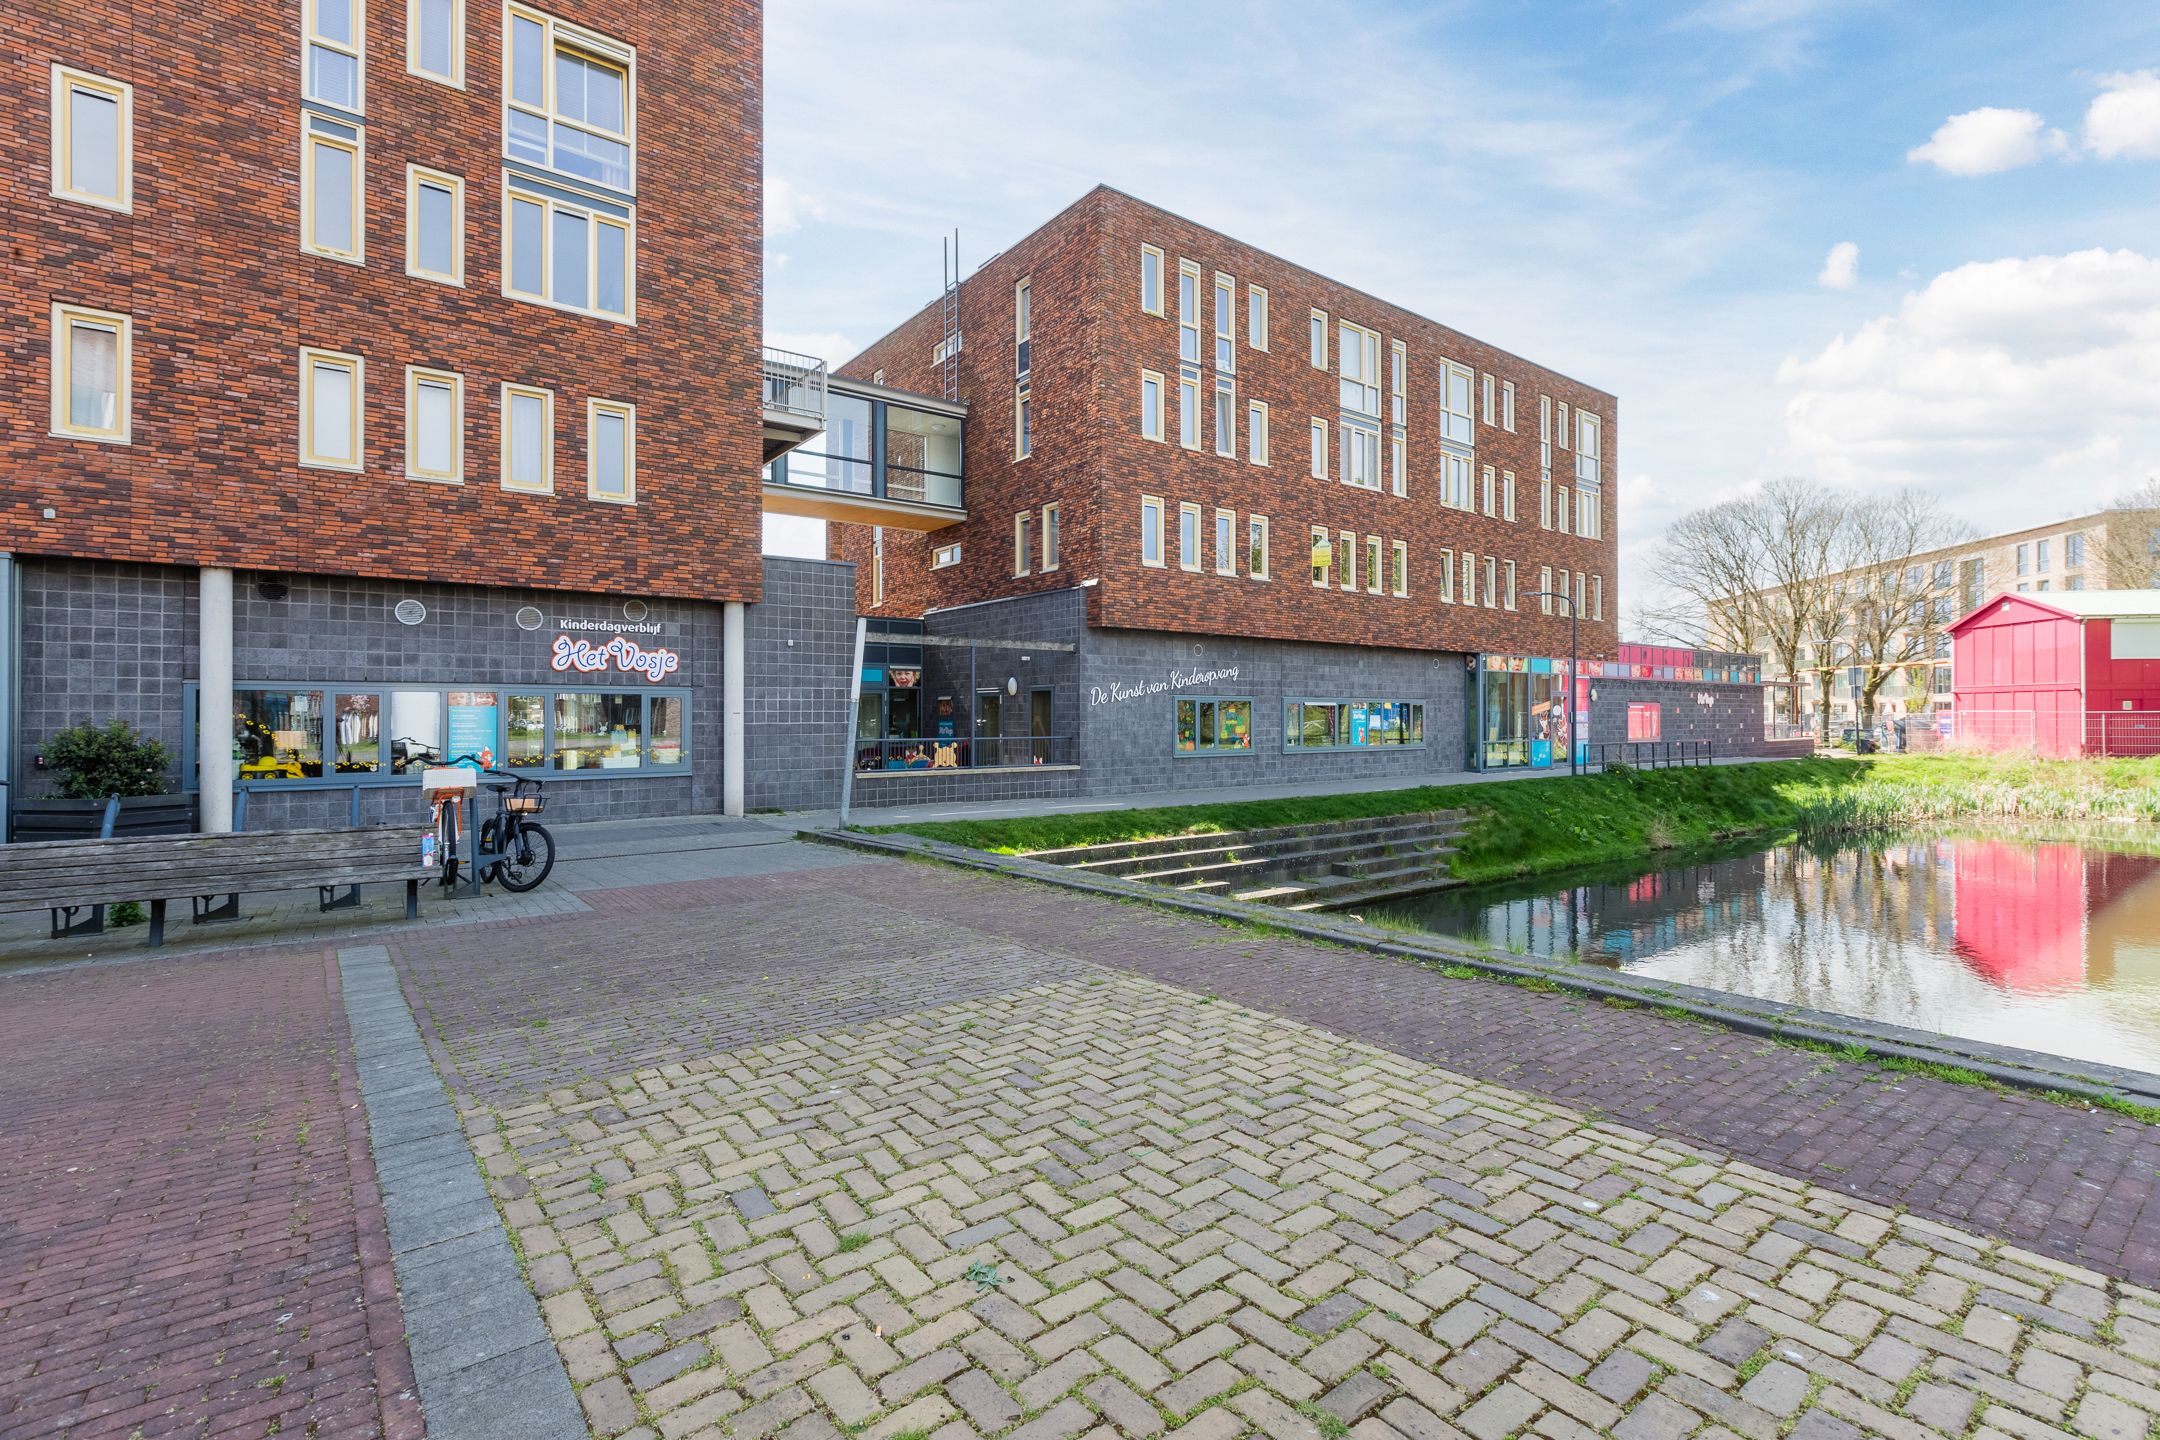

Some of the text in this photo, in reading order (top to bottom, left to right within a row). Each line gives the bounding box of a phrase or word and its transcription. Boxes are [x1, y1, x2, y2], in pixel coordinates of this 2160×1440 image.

[560, 619, 662, 635] Kinderdagverblijf
[556, 638, 676, 679] Het Vosje
[1090, 666, 1239, 706] De Kunst van Kinderopvang
